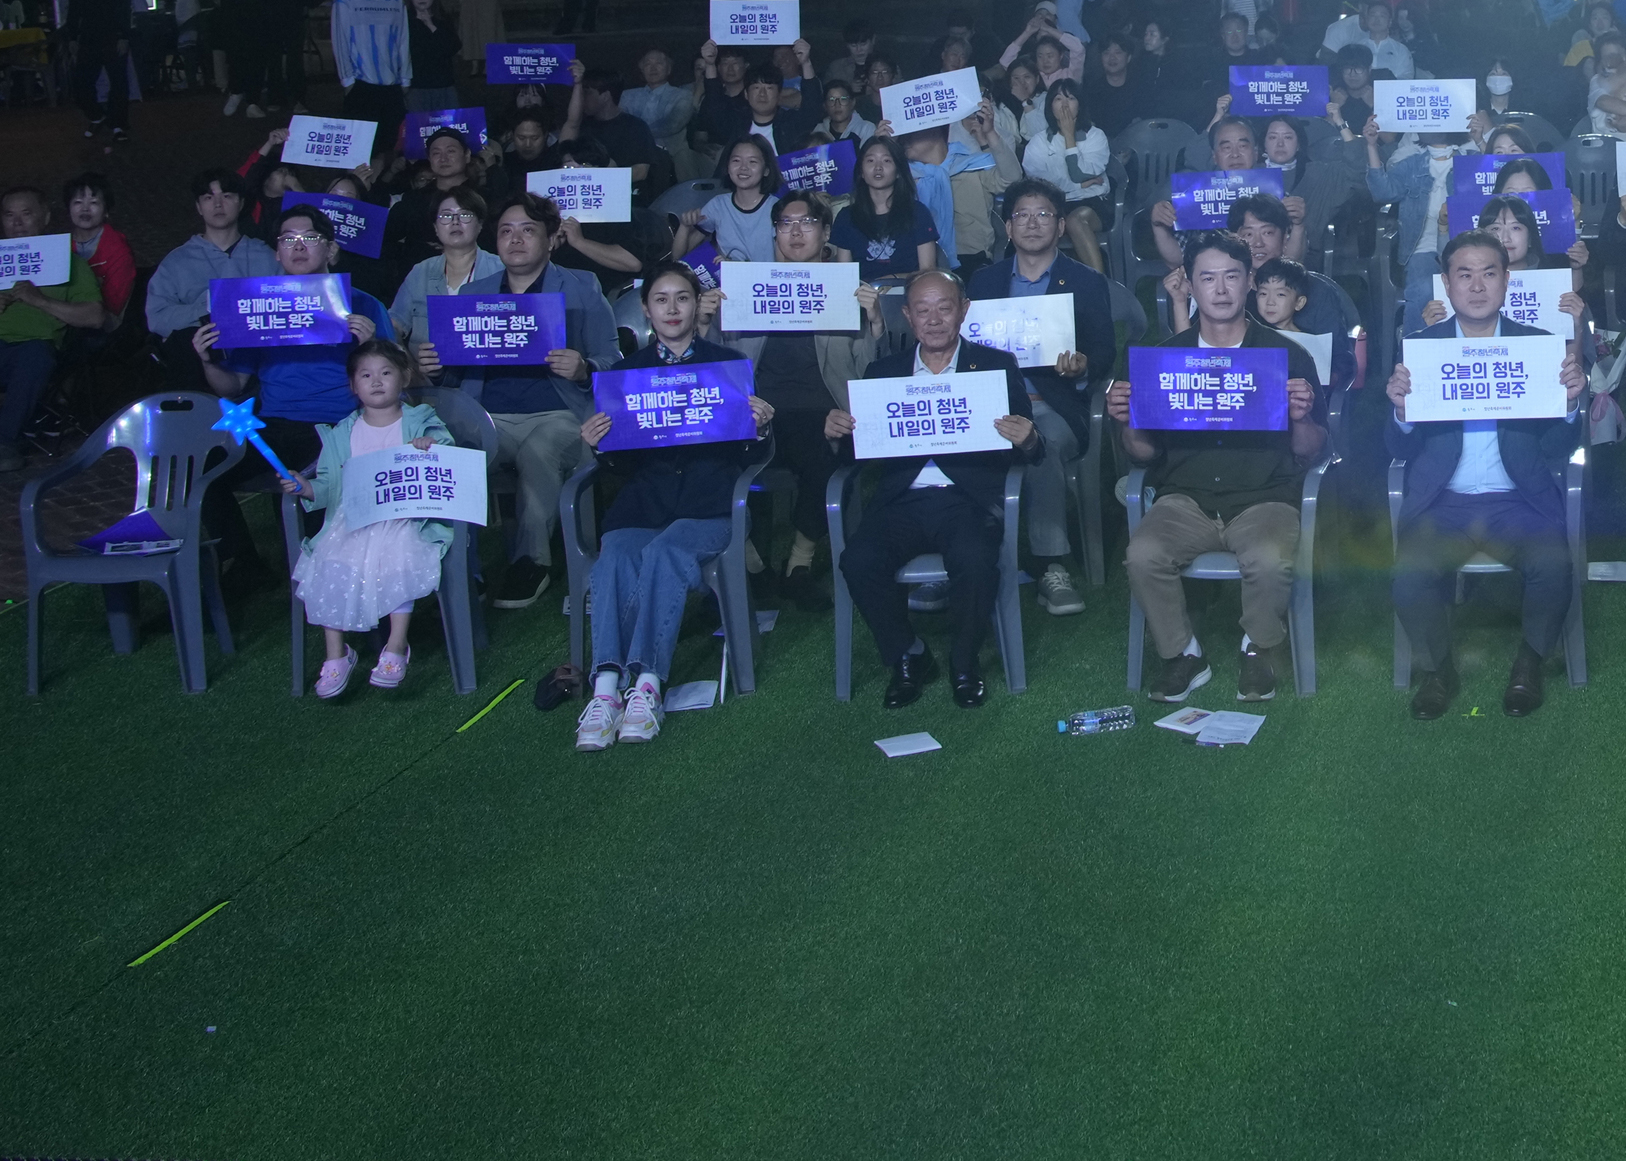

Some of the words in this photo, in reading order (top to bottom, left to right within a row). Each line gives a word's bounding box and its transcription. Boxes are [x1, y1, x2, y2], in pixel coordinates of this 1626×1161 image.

[730, 13, 756, 23] 오늘의
[759, 13, 779, 23] 청년,
[730, 24, 757, 34] 내일의
[760, 24, 777, 34] 원주
[504, 56, 538, 65] 함께하는
[540, 57, 558, 66] 청년,
[510, 66, 534, 74] 빛나는
[536, 66, 552, 74] 원주
[1248, 81, 1286, 92] 함께하는
[1289, 81, 1309, 92] 청년,
[903, 92, 931, 108] 오늘의
[934, 88, 958, 101] 청년,
[1254, 94, 1282, 104] 빛나는
[1284, 93, 1302, 104] 원주
[1396, 96, 1425, 107] 오늘의
[1429, 96, 1452, 107] 청년,
[905, 104, 935, 120] 내일의
[938, 100, 957, 113] 원주
[1397, 109, 1427, 120] 내일의
[1431, 108, 1450, 120] 원주
[308, 131, 333, 143] 오늘의
[334, 134, 352, 145] 청년,
[305, 143, 332, 155] 내일의
[333, 145, 349, 156] 원주
[814, 156, 837, 173] 청년,
[814, 170, 832, 188] 원주
[1475, 171, 1498, 185] 함께
[548, 185, 577, 198] 오늘의
[580, 184, 605, 196] 청년,
[1193, 186, 1236, 202] 함께하는
[1238, 186, 1259, 198] 청년
[558, 199, 578, 211] 일의
[582, 198, 602, 209] 원주
[1201, 202, 1230, 215] 빛나는
[346, 214, 365, 229] 청년,
[339, 225, 357, 238] 원주
[18, 252, 43, 264] 청년,
[20, 264, 41, 275] 원주
[753, 283, 792, 297] 오늘의
[797, 283, 827, 298] 청년,
[238, 298, 292, 313] 함께하는
[295, 295, 326, 311] 청년,
[753, 300, 794, 314] 내일의
[799, 300, 824, 314] 원주
[1510, 292, 1540, 307] 청년,
[247, 315, 286, 330] 빛나는
[289, 313, 313, 328] 원주
[453, 316, 507, 331] 함께하는
[510, 315, 538, 331] 청년,
[1513, 309, 1538, 323] 원주
[462, 333, 501, 348] 빛나는
[504, 333, 528, 347] 원주
[1441, 362, 1487, 380] 오늘의
[1493, 361, 1528, 379] 청년,
[1159, 373, 1220, 390] 함께하는
[1224, 373, 1257, 392] 청년,
[1442, 382, 1490, 400] 내일의
[1496, 381, 1525, 398] 원주
[626, 391, 687, 410] 함께하는
[690, 387, 724, 404] 청년,
[1169, 393, 1213, 409] 빛나는
[1217, 393, 1244, 410] 원주
[886, 400, 932, 418] 오늘의
[936, 397, 972, 415] 청년,
[637, 410, 682, 429] 빛나는
[685, 407, 713, 424] 원주
[889, 419, 936, 438] 내일의
[941, 417, 970, 434] 원주
[375, 466, 419, 487] 오늘의
[424, 466, 456, 485] 청년,
[376, 485, 422, 505] 내일의
[428, 485, 454, 501] 원주
